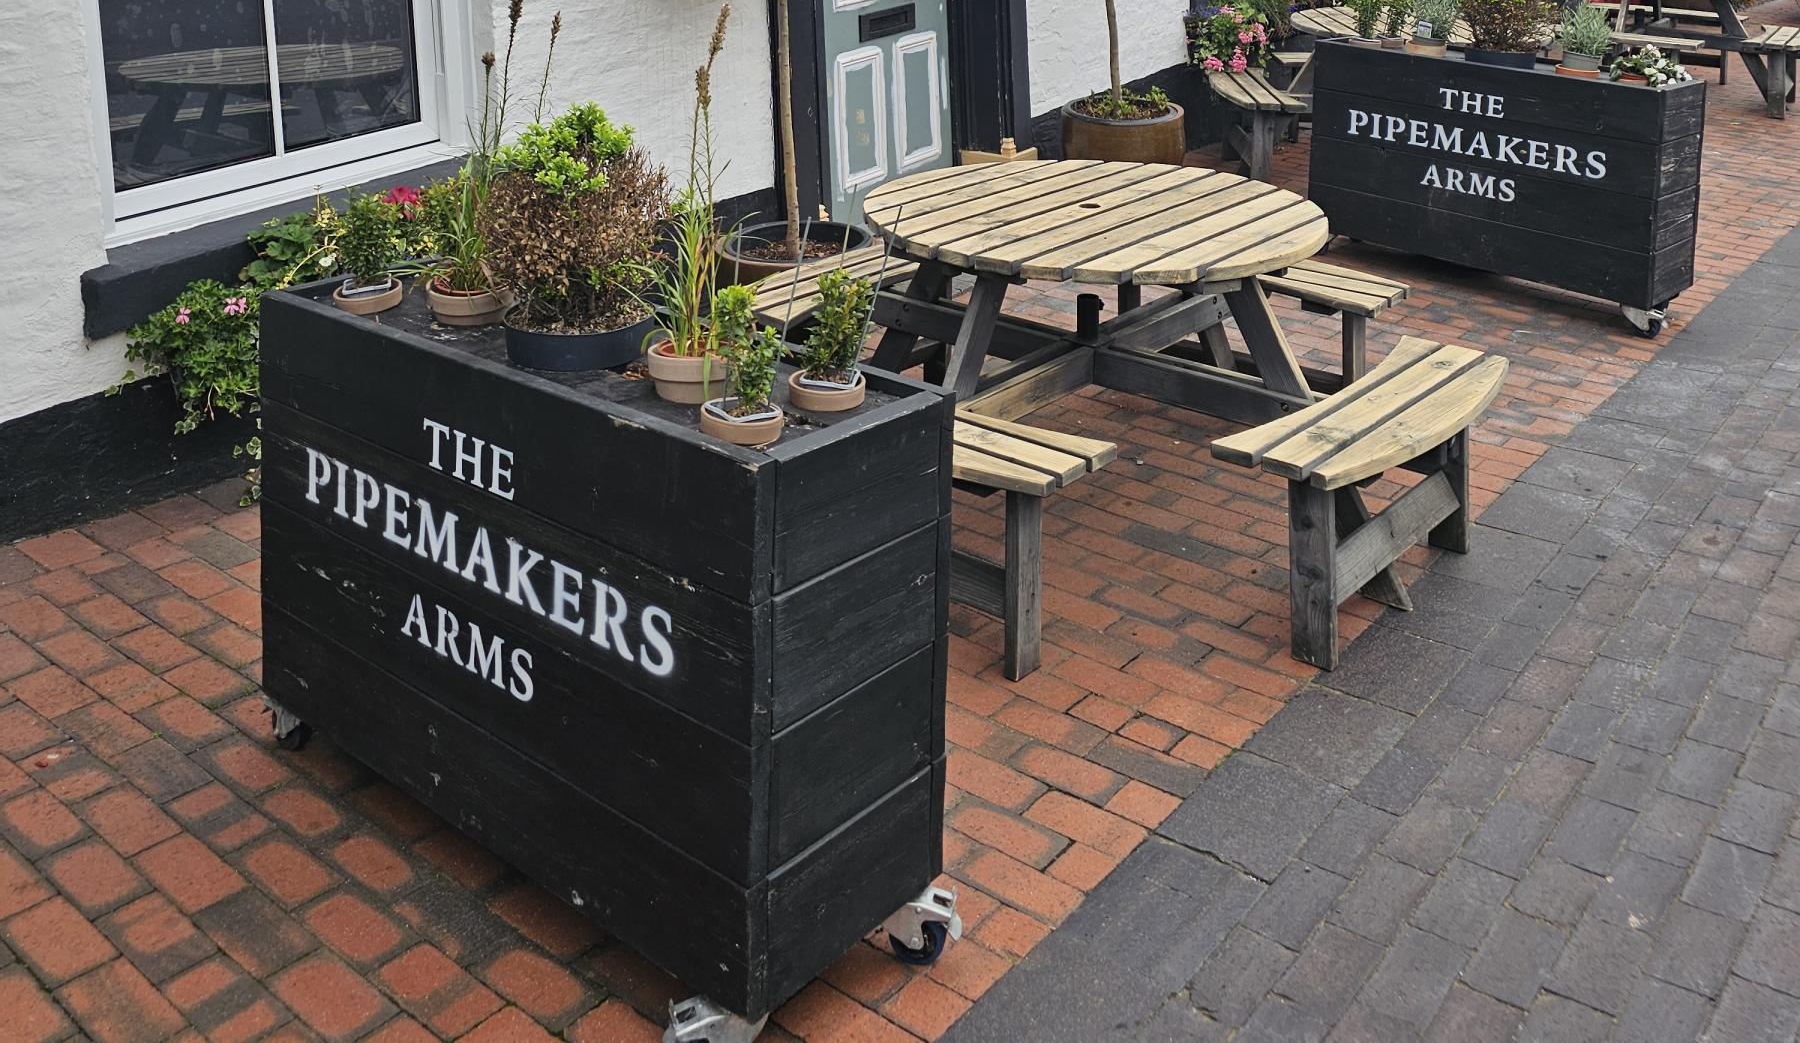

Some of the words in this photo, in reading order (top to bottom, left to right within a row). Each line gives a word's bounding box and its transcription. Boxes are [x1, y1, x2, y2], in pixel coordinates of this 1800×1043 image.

[1439, 87, 1506, 119] THE
[1347, 109, 1608, 179] PIPEMAKERS
[1420, 164, 1517, 203] ARMS
[423, 417, 515, 501] THE
[305, 446, 676, 678] PIPEMAKERS
[400, 593, 535, 704] ARMS
